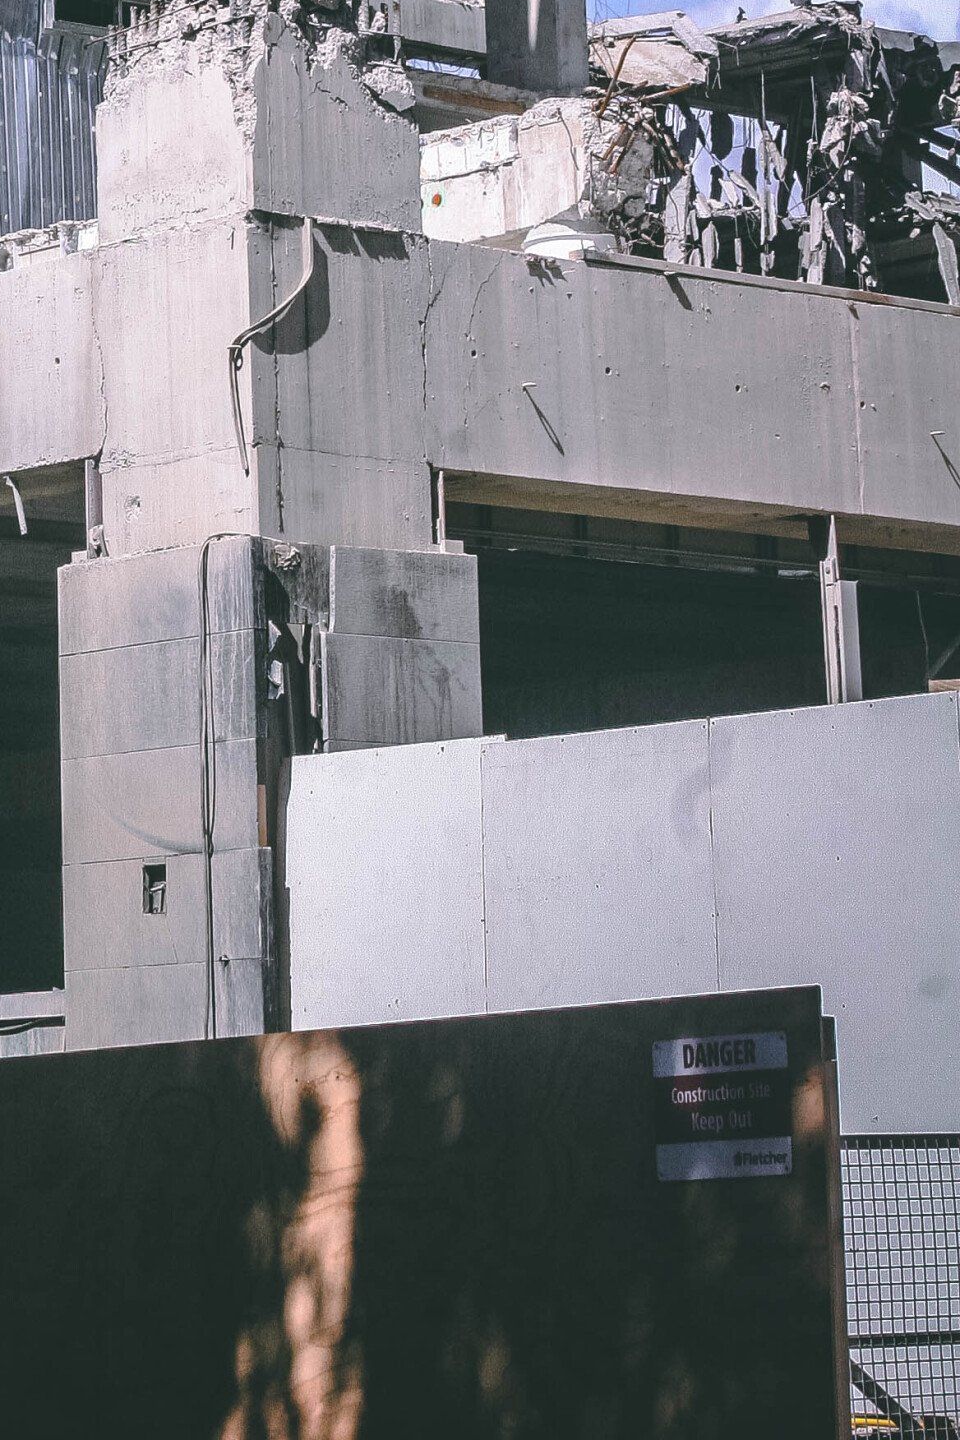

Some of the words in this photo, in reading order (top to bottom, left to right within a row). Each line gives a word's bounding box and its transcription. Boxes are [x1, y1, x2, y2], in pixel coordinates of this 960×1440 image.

[682, 1039, 756, 1069] DANGER
[671, 1083, 744, 1104] Construction
[749, 1080, 771, 1099] Site
[691, 1111, 724, 1133] Keep
[729, 1110, 752, 1128] Out
[743, 1150, 788, 1166] Fletcher
